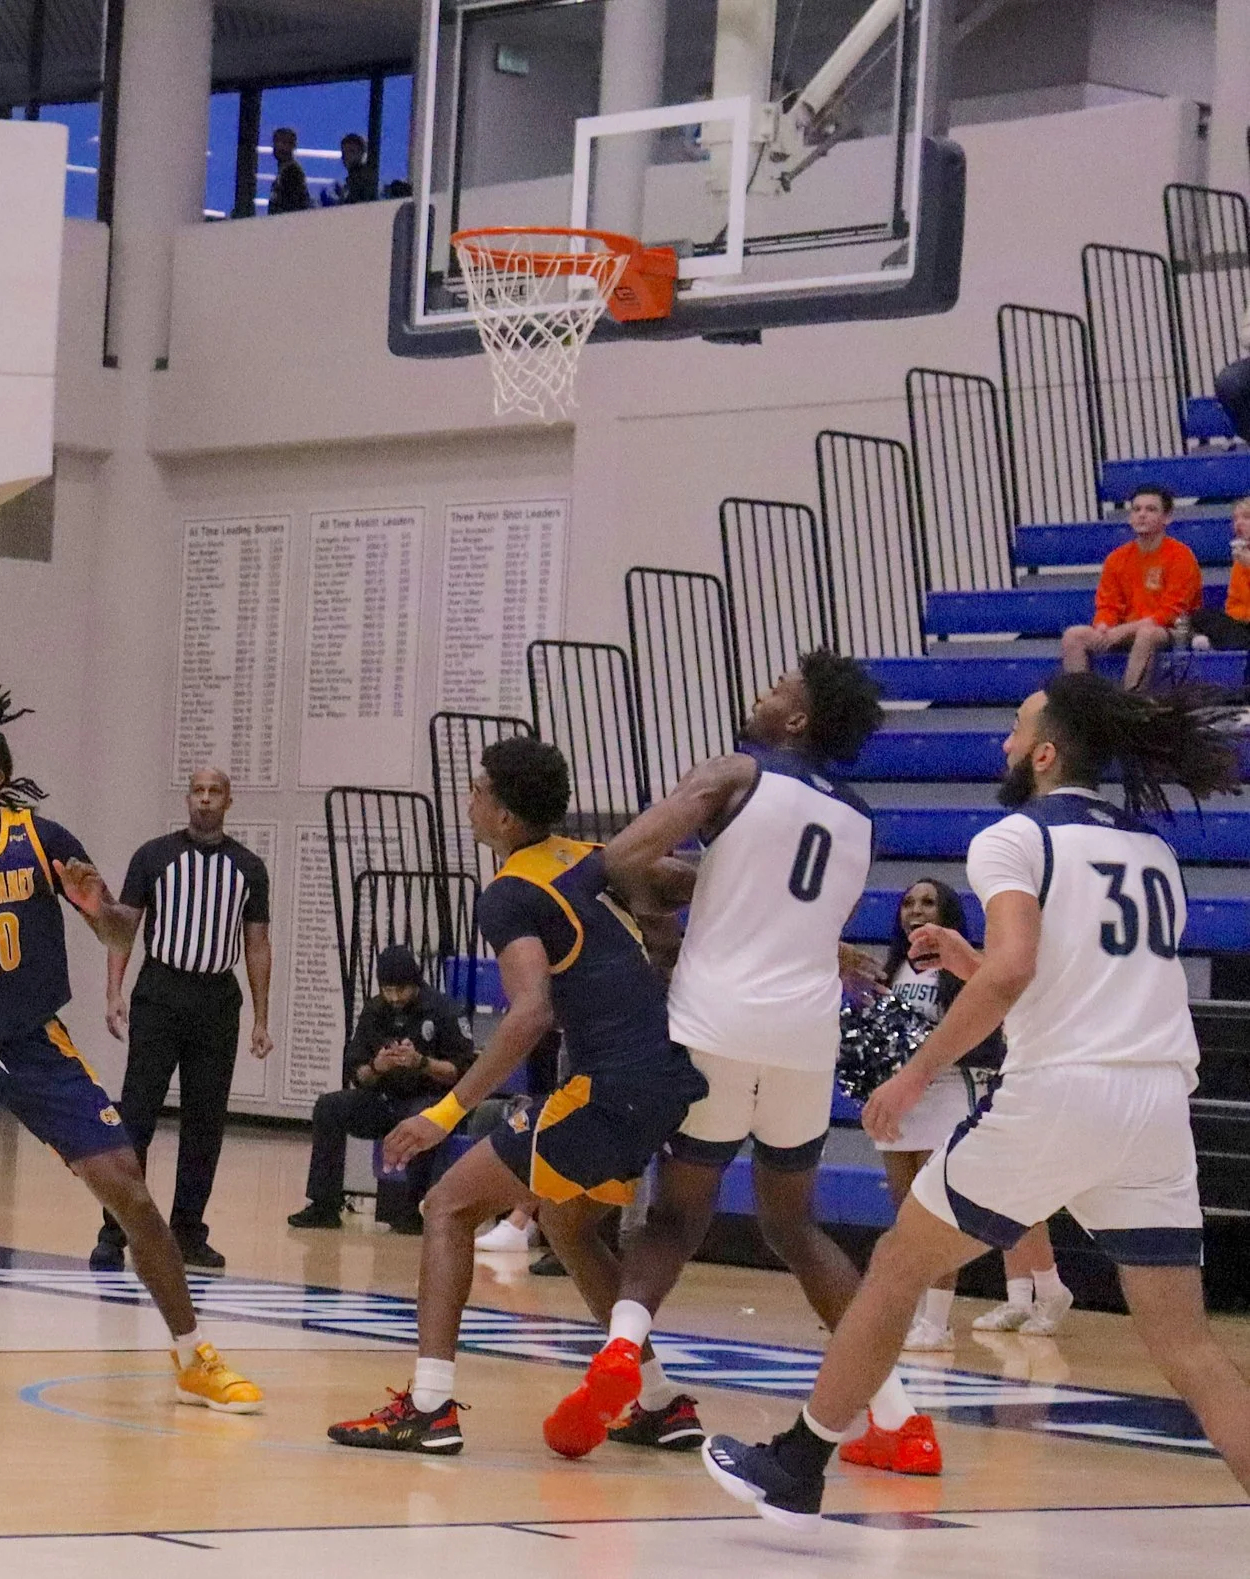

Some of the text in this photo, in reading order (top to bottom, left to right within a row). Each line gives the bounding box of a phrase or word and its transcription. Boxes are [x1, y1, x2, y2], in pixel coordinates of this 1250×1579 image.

[787, 822, 832, 903] 0
[1087, 860, 1177, 961] 30
[893, 983, 938, 1004] UGUST
